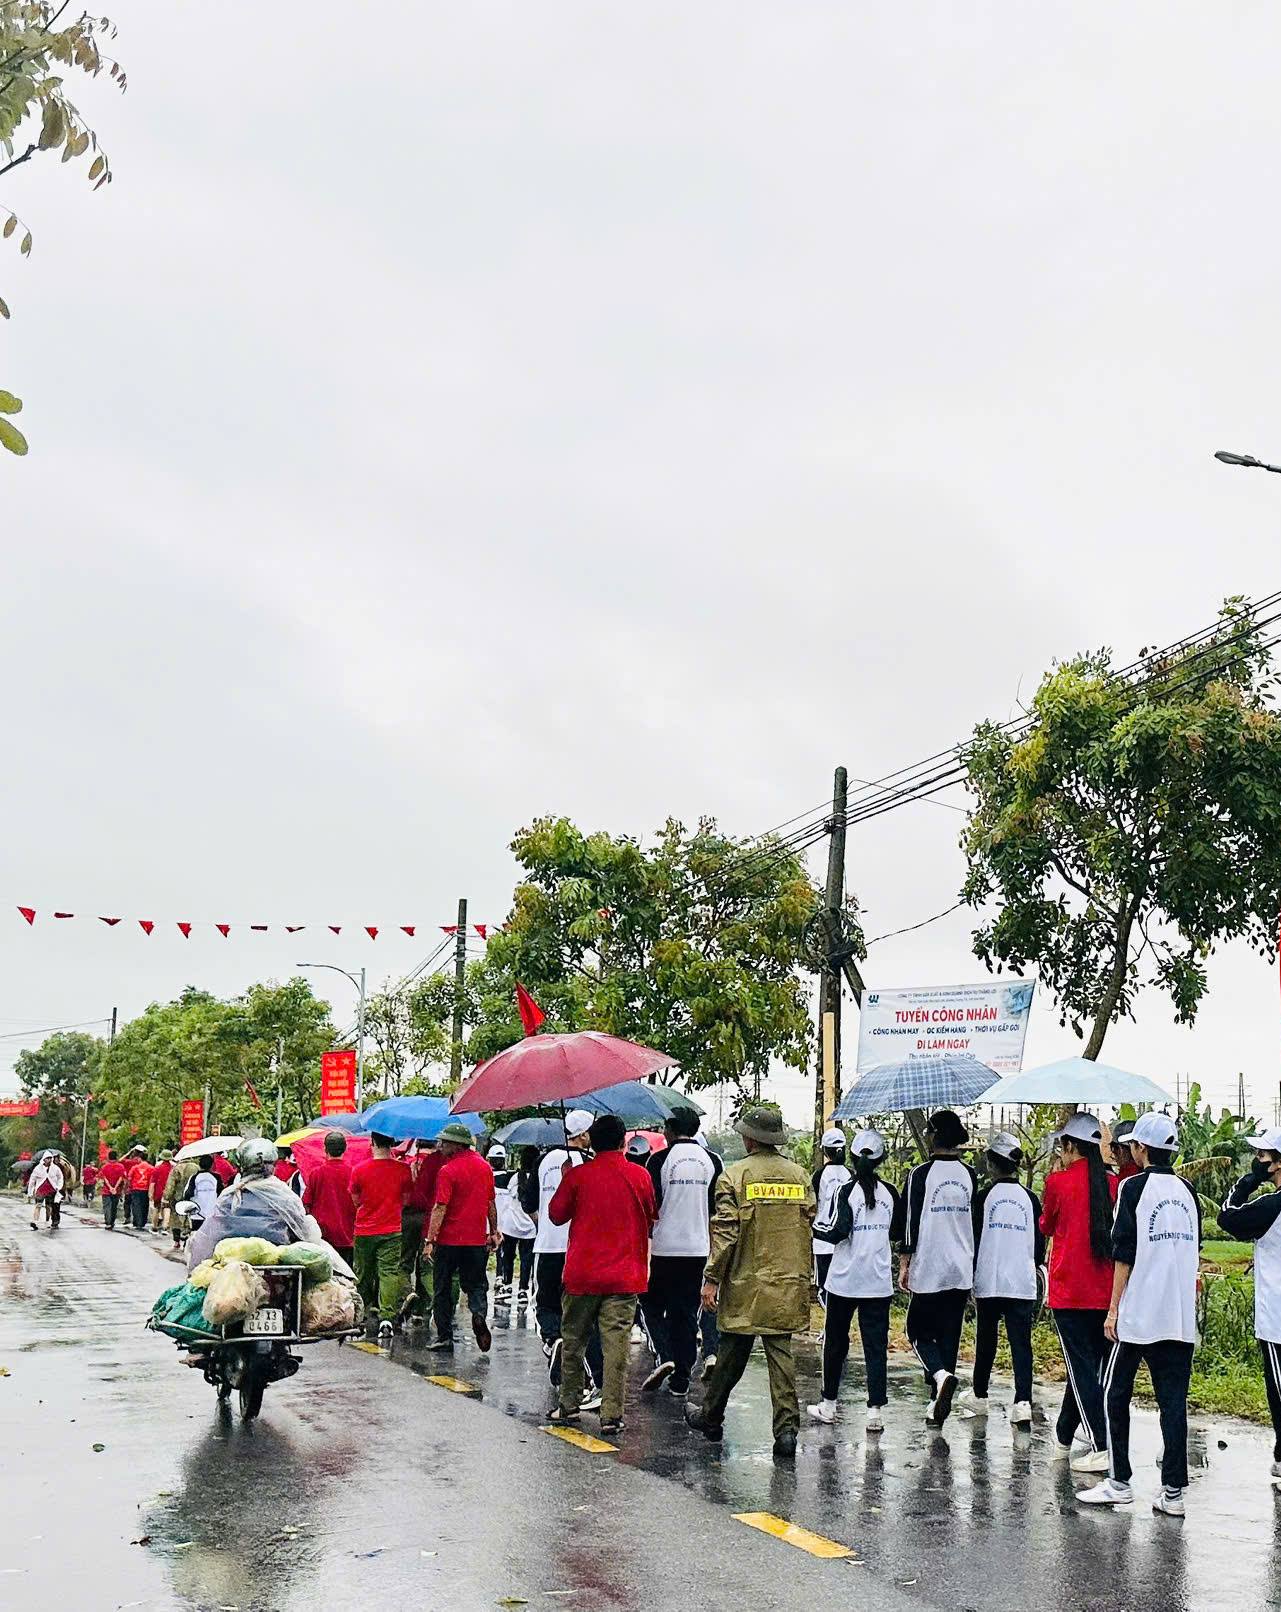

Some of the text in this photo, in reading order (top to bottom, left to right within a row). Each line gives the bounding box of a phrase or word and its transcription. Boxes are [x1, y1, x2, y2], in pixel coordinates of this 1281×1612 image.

[896, 1004, 998, 1023] TUYỂN CÔNG NHÂN
[917, 1039, 925, 1049] ĐI
[947, 1039, 970, 1049] NGAY
